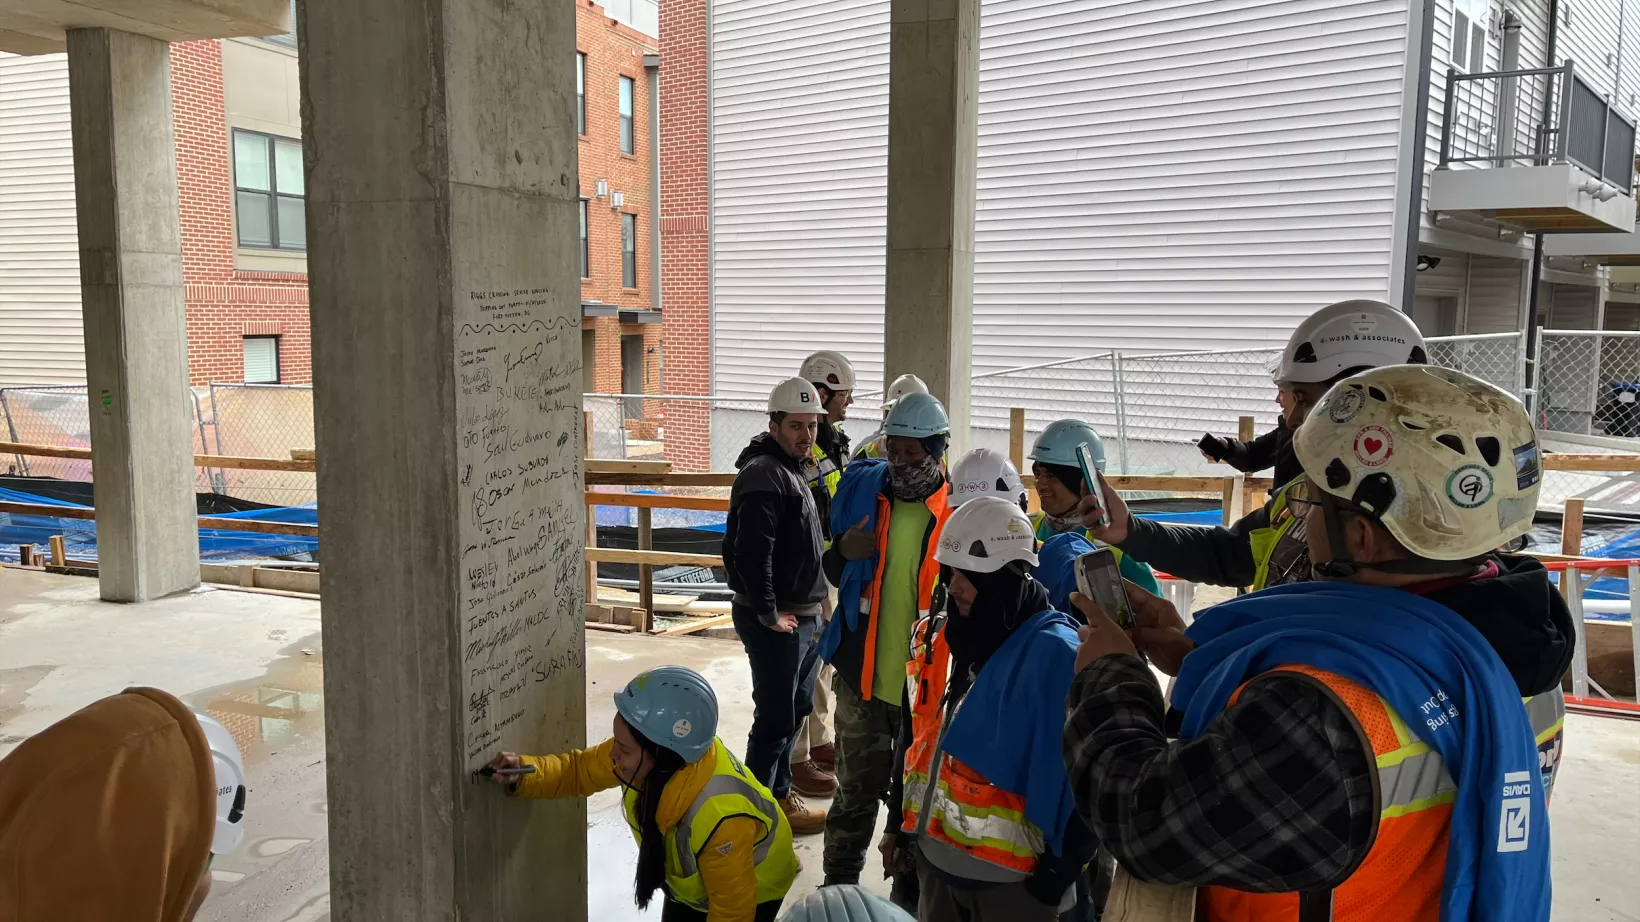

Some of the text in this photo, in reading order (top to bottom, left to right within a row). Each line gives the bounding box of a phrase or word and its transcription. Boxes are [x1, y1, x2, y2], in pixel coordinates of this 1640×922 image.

[471, 291, 486, 300] RIGGS
[1329, 334, 1350, 343] wash
[1361, 334, 1406, 345] associates
[1420, 696, 1441, 715] Out
[1503, 783, 1531, 796] DAVIS
